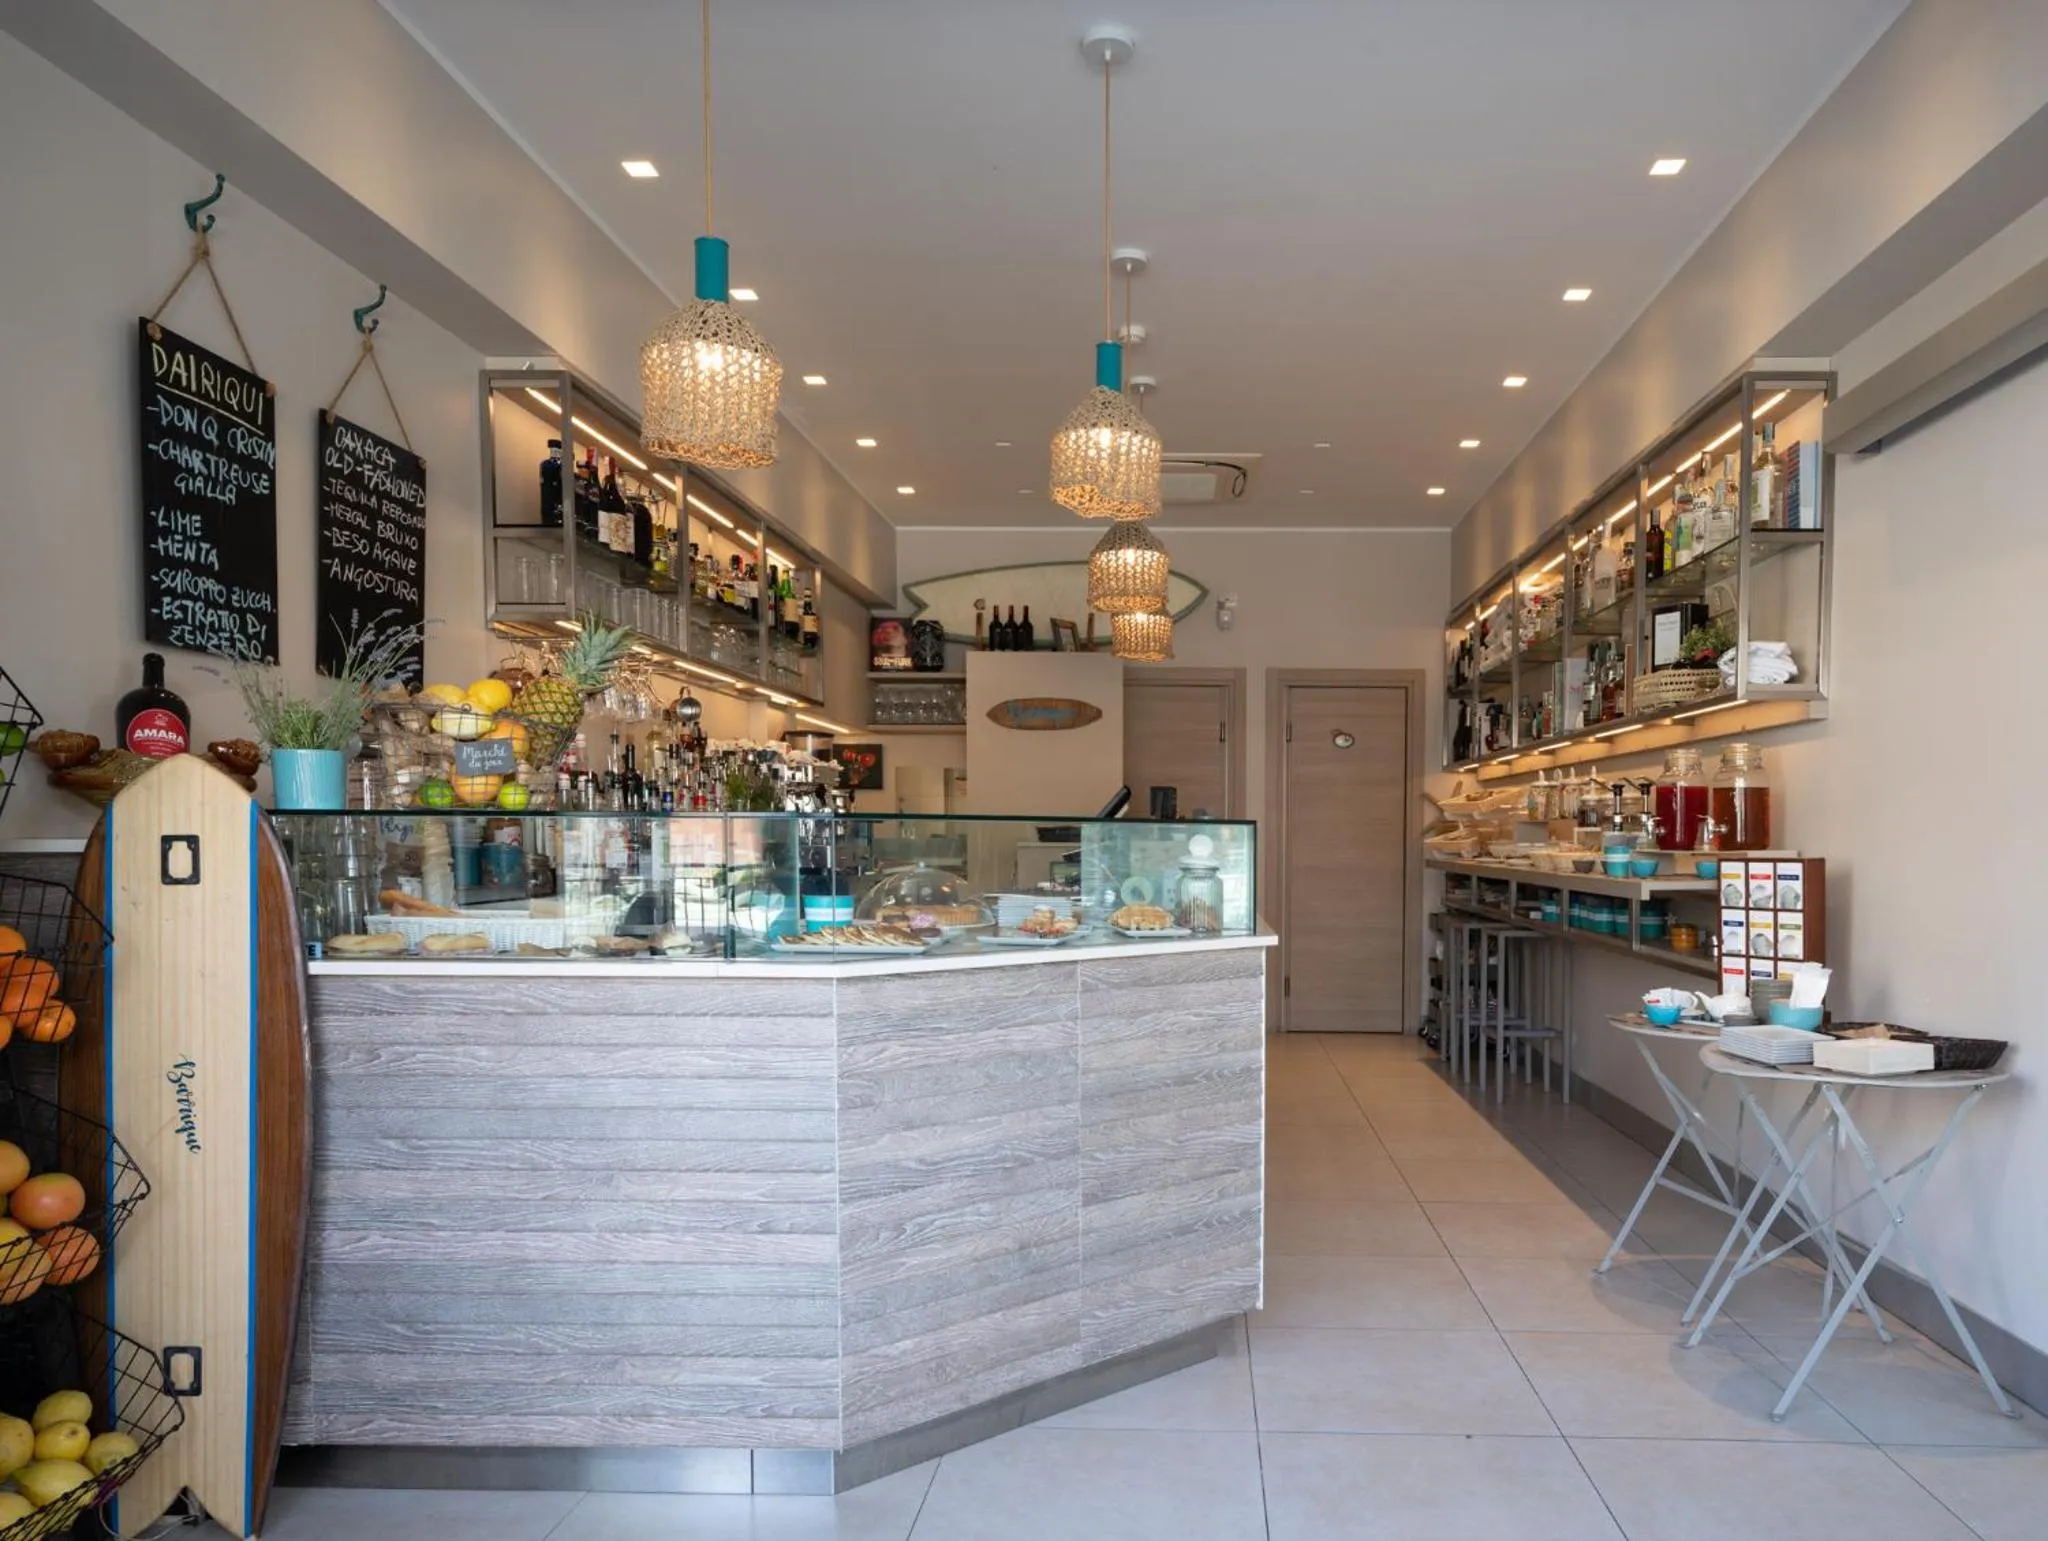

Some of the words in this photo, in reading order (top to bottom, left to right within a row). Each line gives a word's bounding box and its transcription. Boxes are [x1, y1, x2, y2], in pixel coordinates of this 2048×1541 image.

[151, 342, 264, 426] DAIRIQUI
[201, 416, 220, 446] Q
[335, 425, 397, 471] OAXACA
[174, 472, 237, 506] GIALLA
[376, 520, 419, 551] BRUXO
[372, 541, 418, 576] AGAVE
[168, 624, 263, 660] ZENZERO
[246, 612, 267, 641] DI
[133, 728, 186, 746] AMARA
[166, 1053, 202, 1155] Barrique
